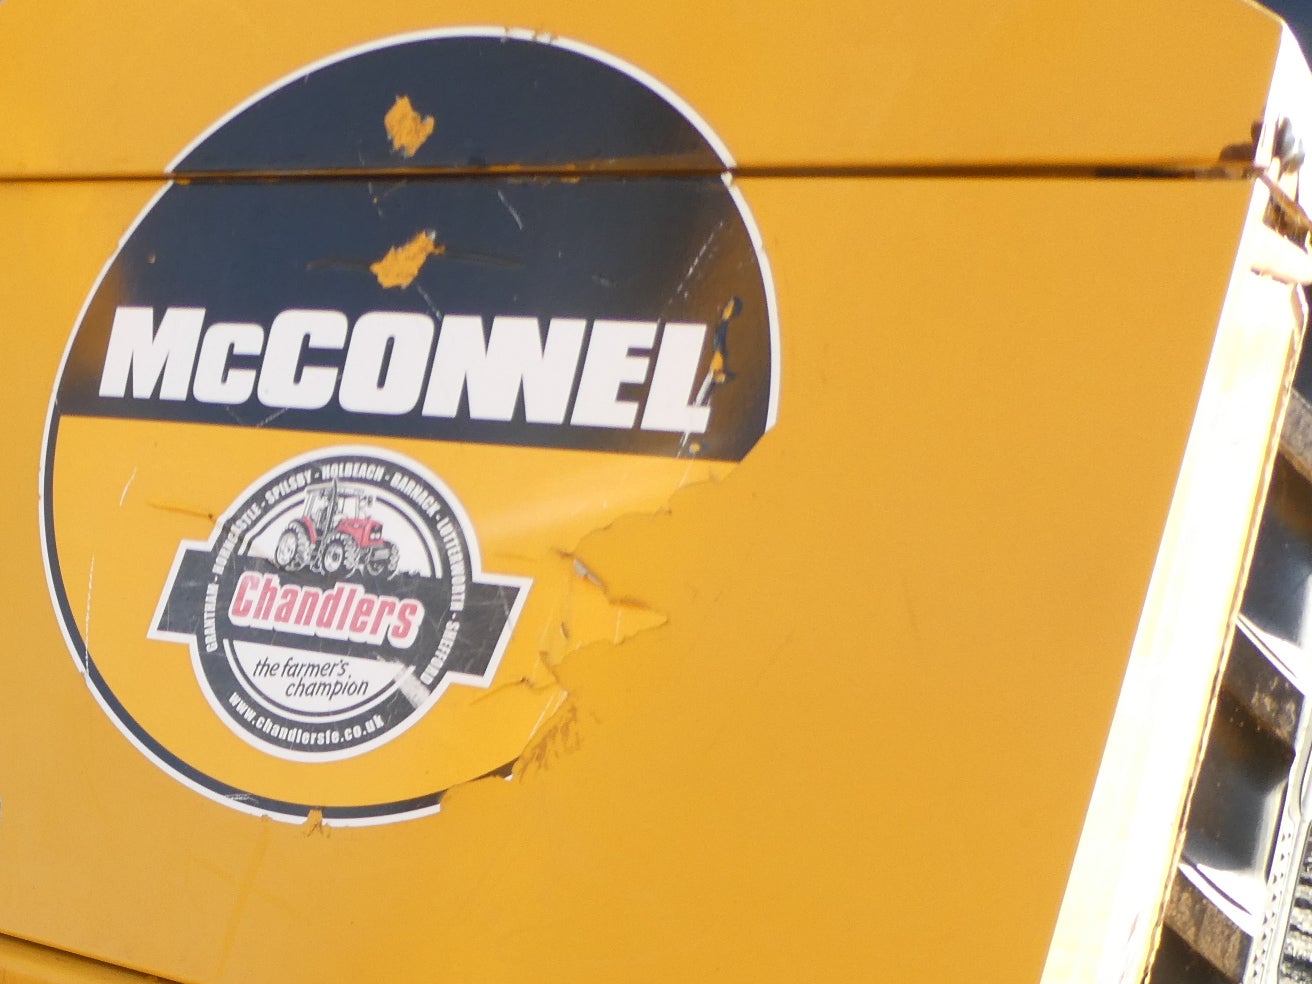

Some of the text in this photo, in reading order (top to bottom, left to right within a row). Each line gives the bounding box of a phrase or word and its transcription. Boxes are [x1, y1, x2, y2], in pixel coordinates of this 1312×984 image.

[231, 574, 419, 640] Chandlers
[253, 656, 349, 679] the farmer's
[285, 674, 369, 701] champion
[229, 691, 385, 746] www.chandlersfe.co.uk
